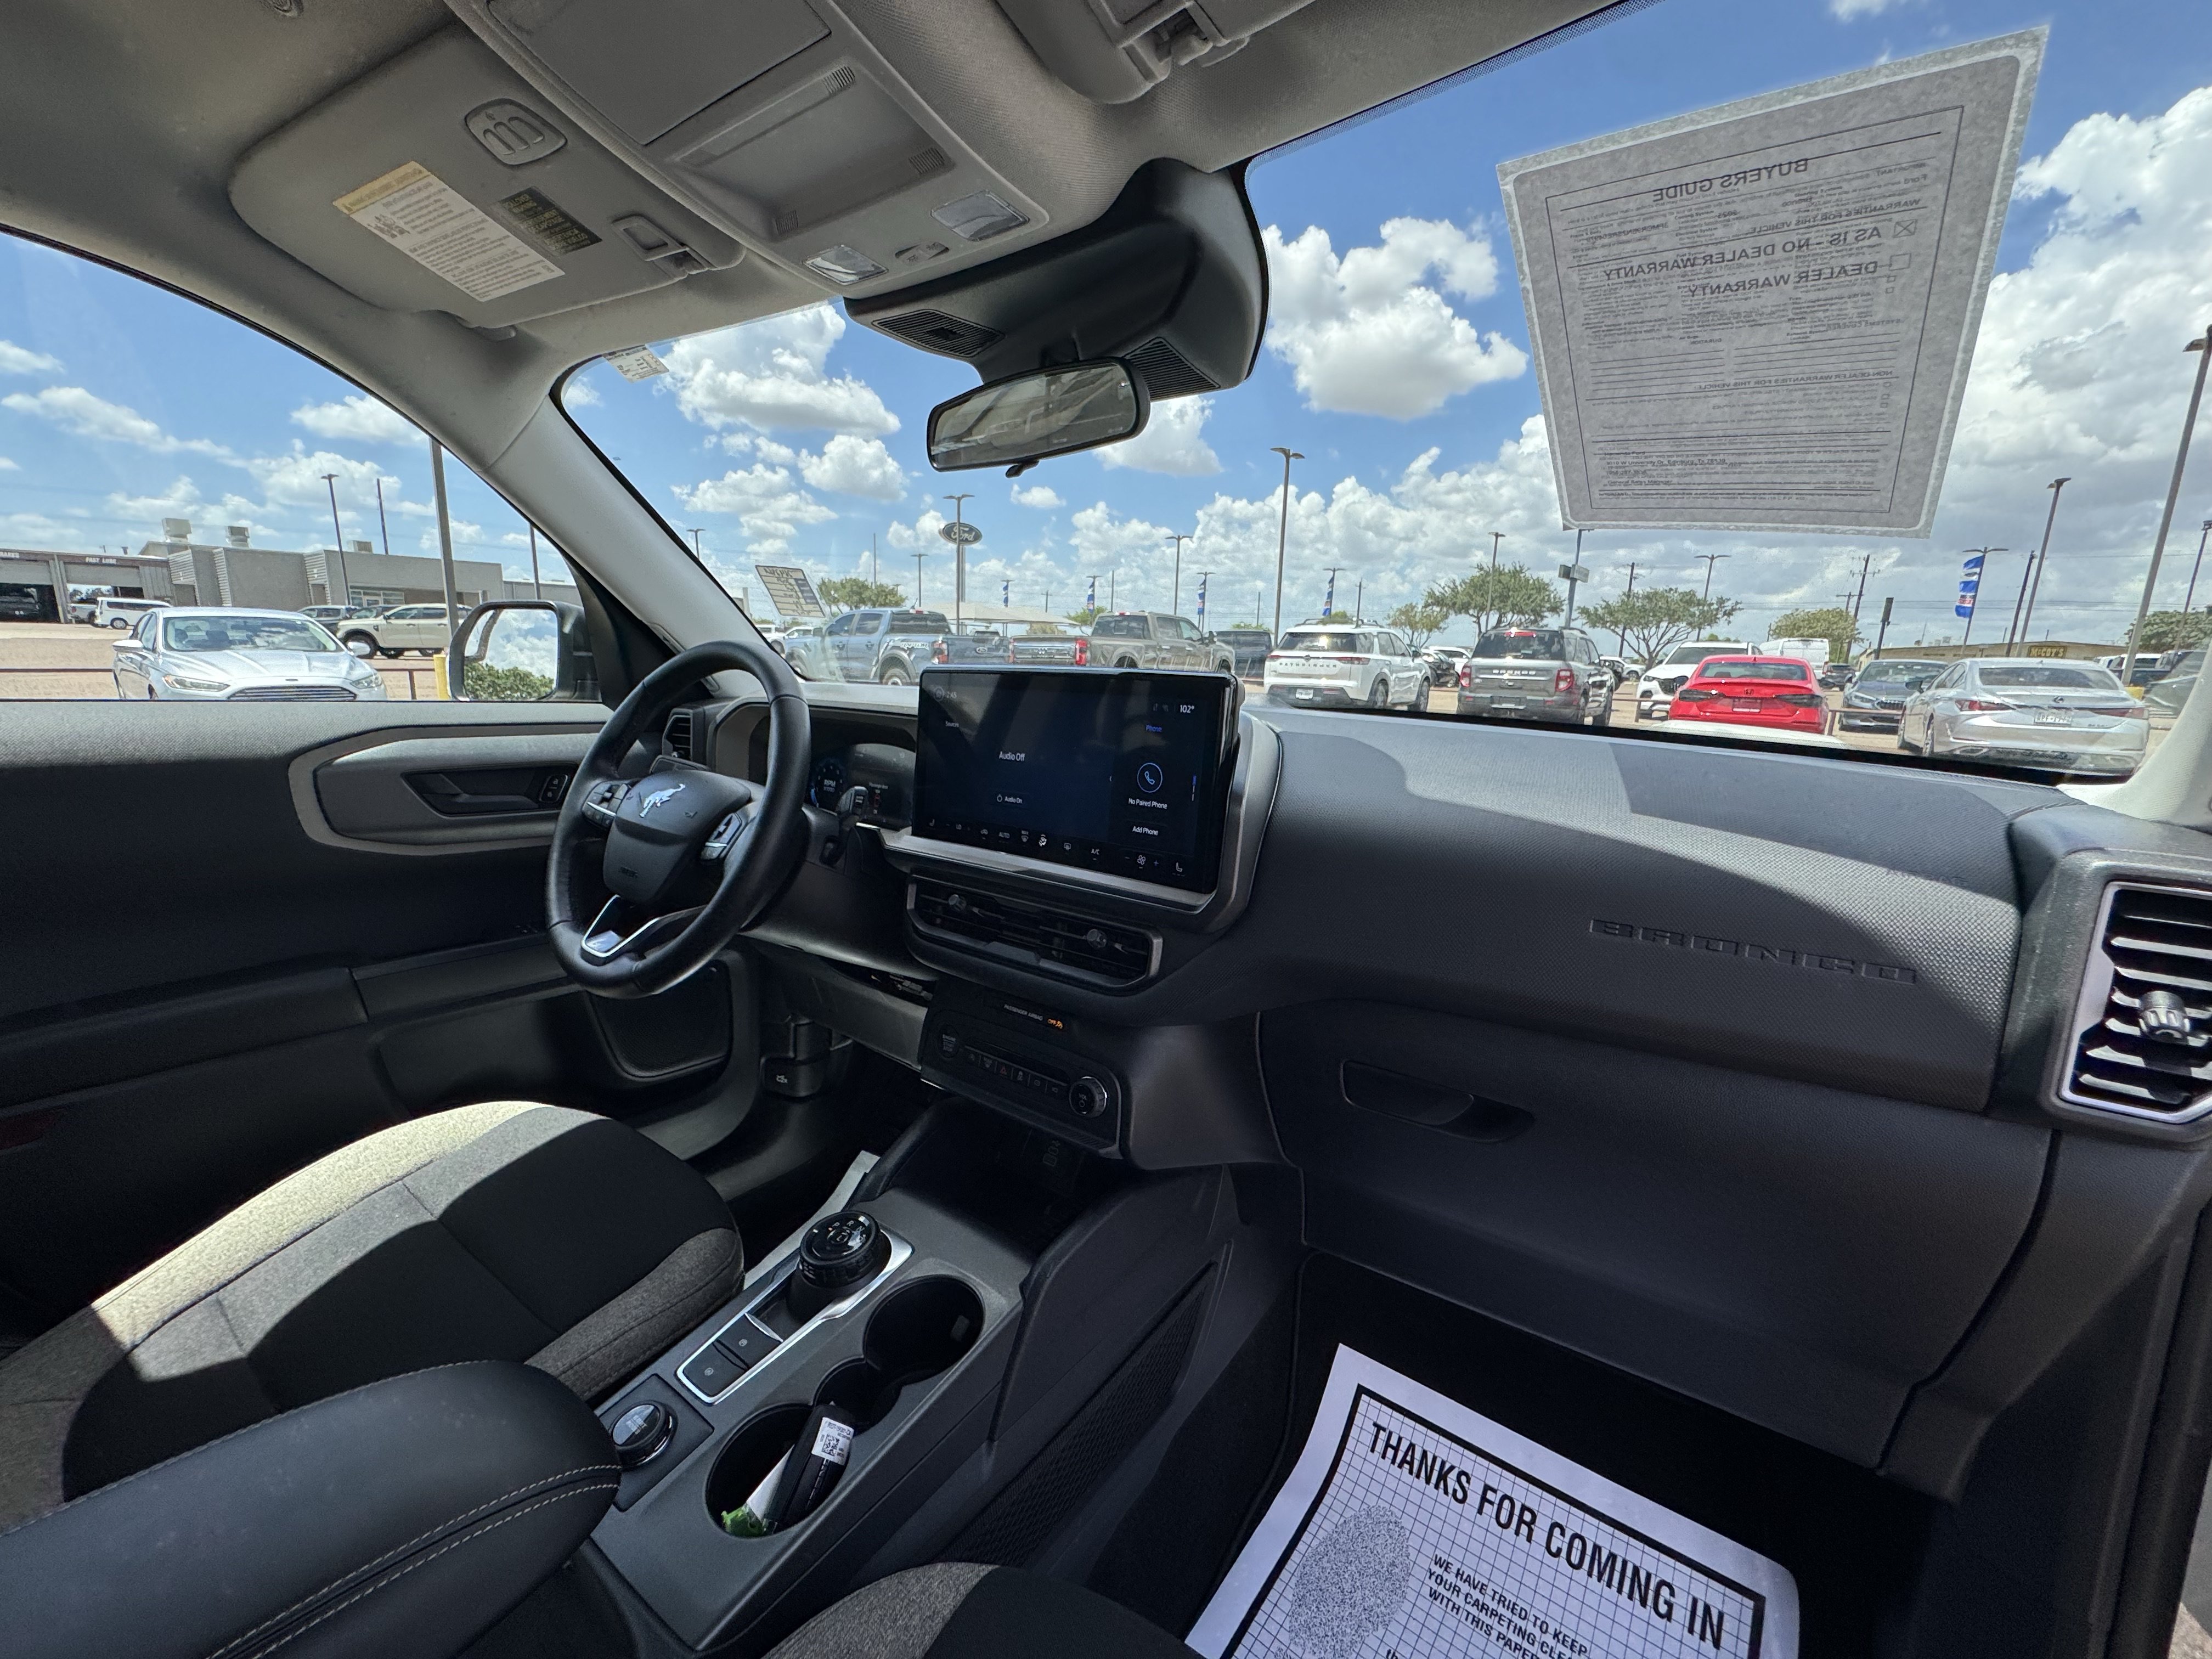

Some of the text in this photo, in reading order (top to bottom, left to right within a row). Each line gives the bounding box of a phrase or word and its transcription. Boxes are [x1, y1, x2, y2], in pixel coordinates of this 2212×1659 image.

[951, 526, 975, 541] Ford
[1146, 724, 1163, 733] Phone
[998, 751, 1025, 761] Audio Off
[1136, 799, 1151, 807] Paired
[1152, 800, 1167, 810] Phone
[1142, 827, 1159, 836] Phone
[1589, 918, 1916, 985] BRONCO
[1369, 1420, 1724, 1651] THANKS FOR COMING IN
[1427, 1568, 1462, 1598] YOUR
[1464, 1592, 1537, 1646] CARPETING
[1429, 1587, 1460, 1616] WITH
[1464, 1609, 1494, 1637] THIS
[1434, 1554, 1588, 1657] WE HAVE TRIED TO KEEP
